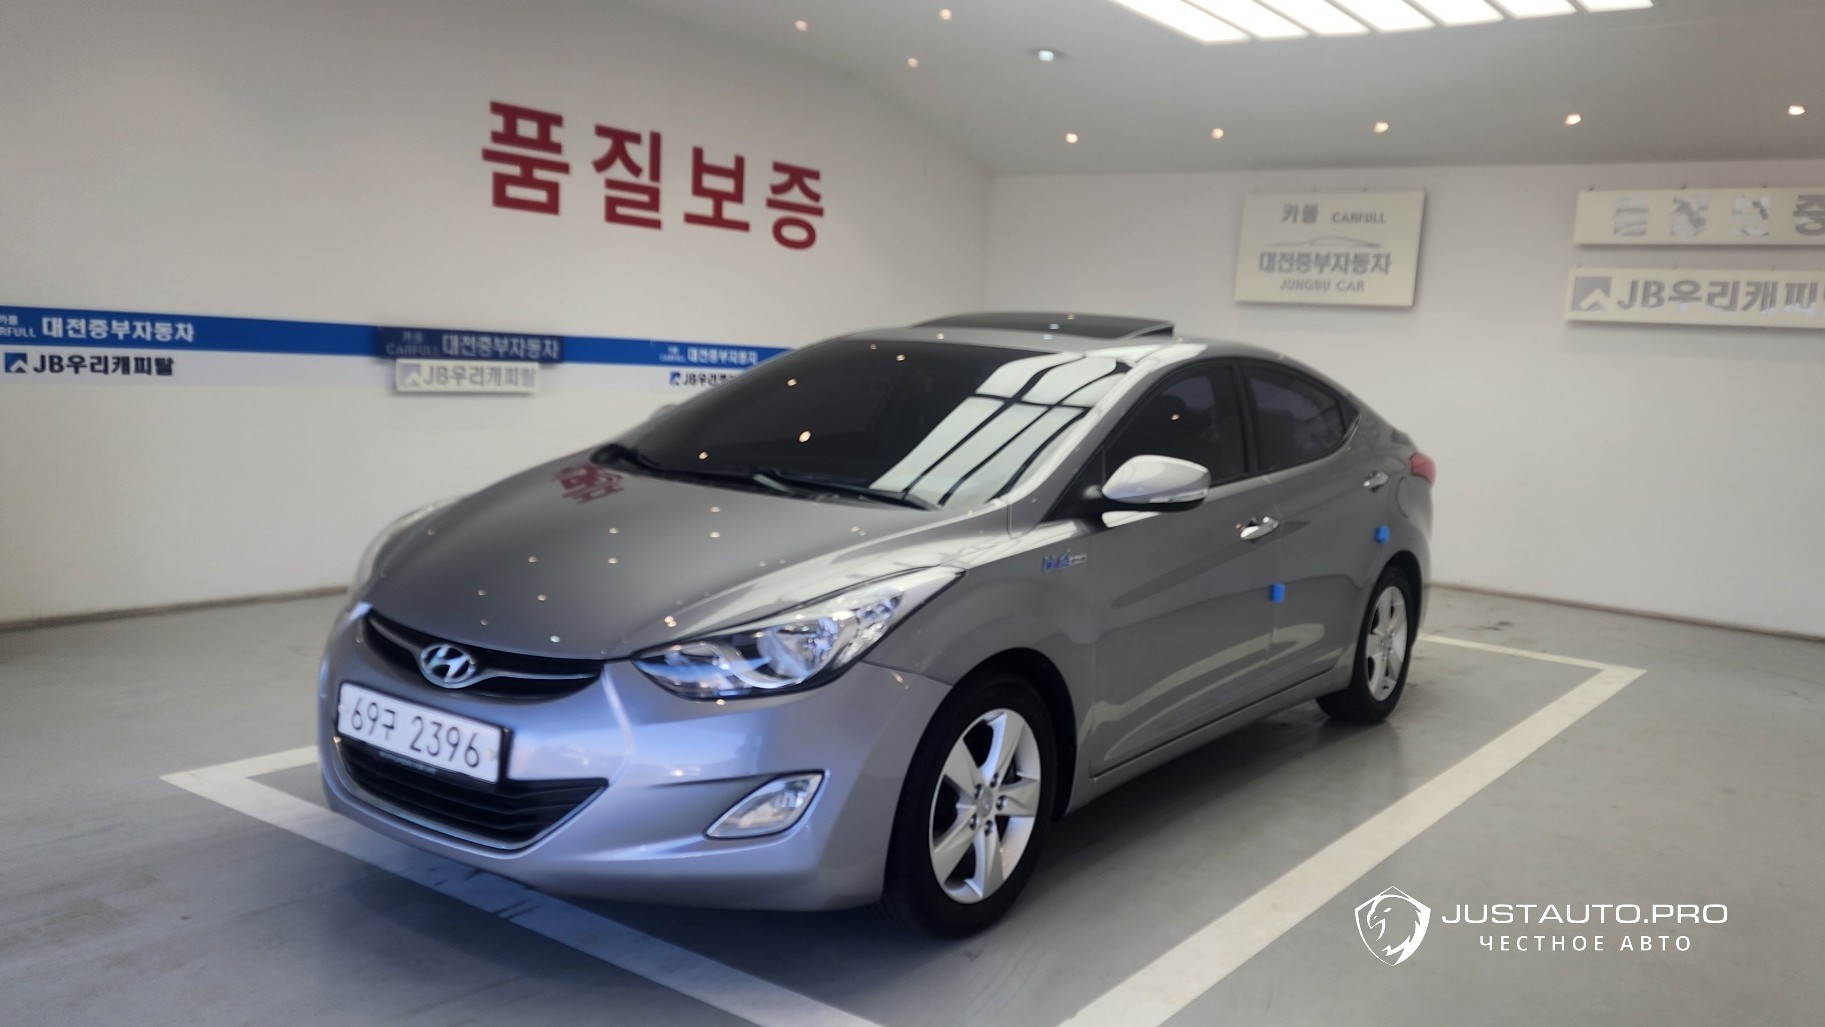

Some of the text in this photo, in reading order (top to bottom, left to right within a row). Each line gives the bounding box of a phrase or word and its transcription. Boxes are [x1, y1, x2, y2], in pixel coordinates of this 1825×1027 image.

[481, 100, 825, 251] 품질보증
[1259, 252, 1392, 275] 대전중부자동차
[1280, 279, 1365, 293] JUNGBU CAR
[1617, 279, 1825, 313] JB우리캐피
[0, 326, 37, 338] RFULL
[42, 317, 195, 343] 대전중부자동차
[442, 334, 559, 360] 대전중부자동차
[33, 354, 174, 376] JB우리캐피탈
[424, 366, 537, 388] JB우리캐피탈
[351, 698, 396, 741] 69구
[409, 715, 480, 768] 2396
